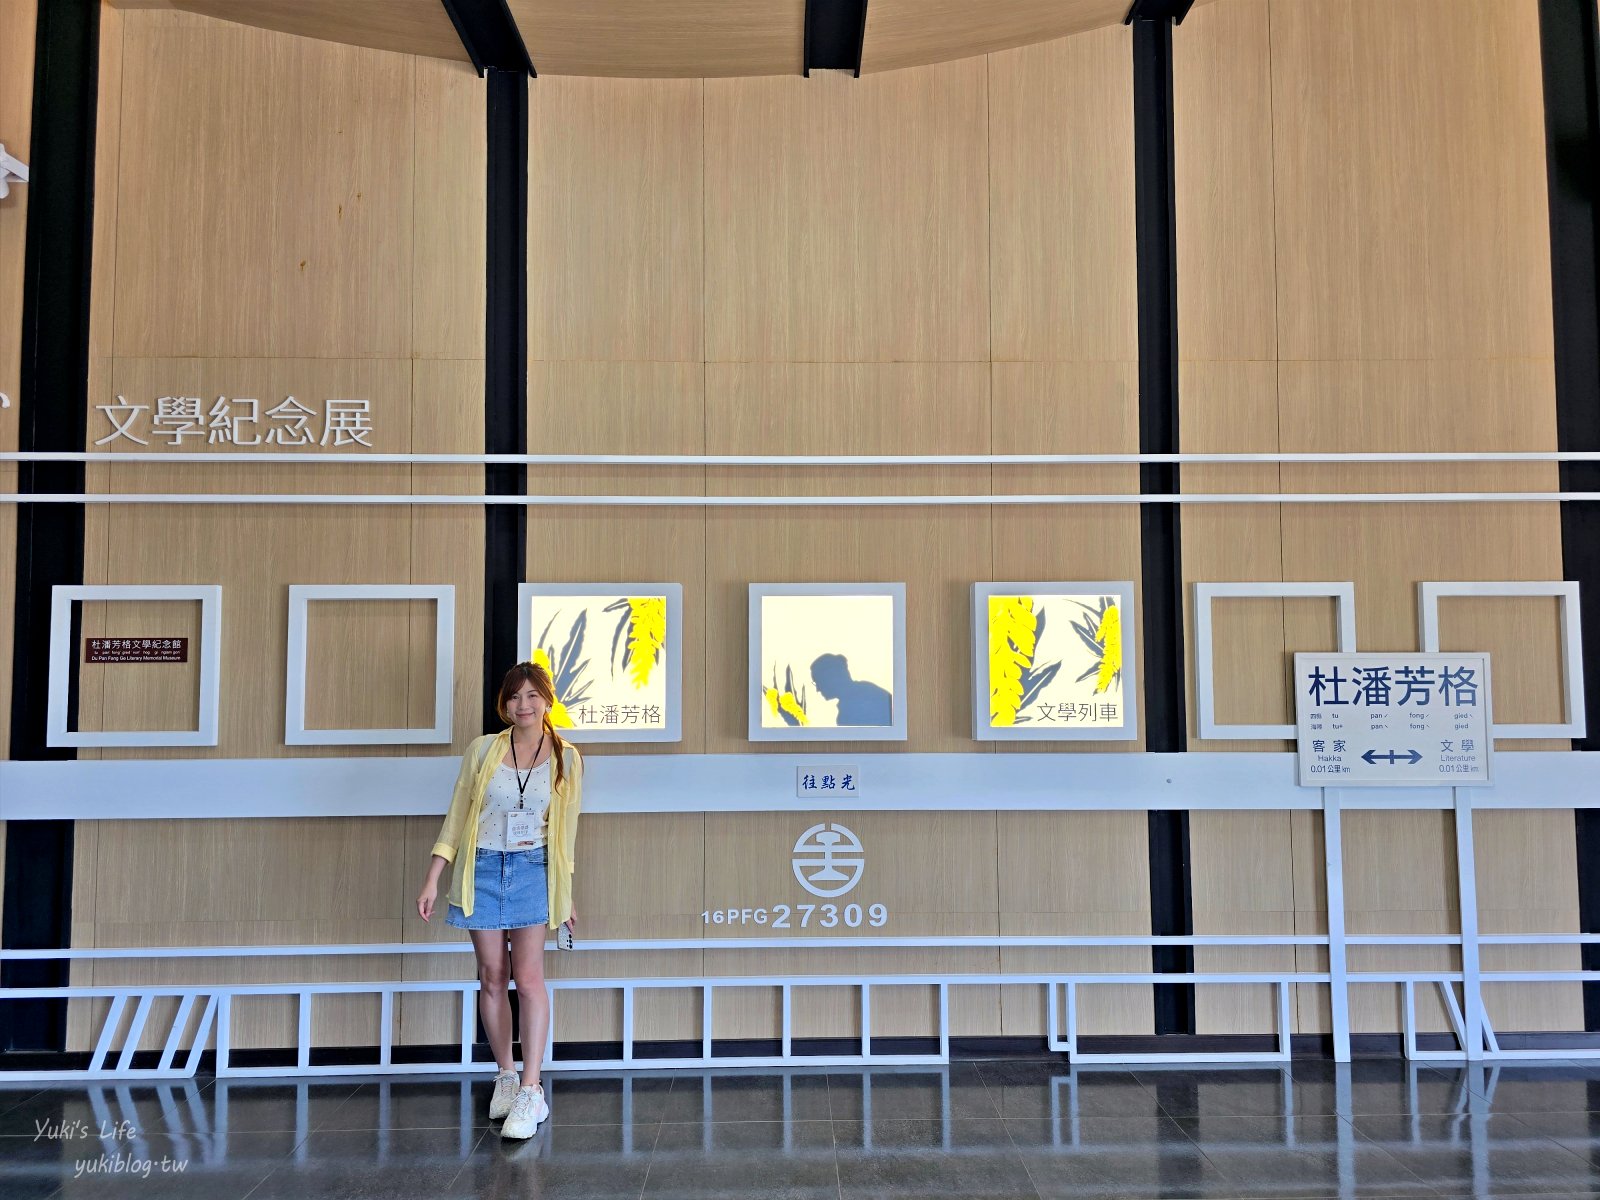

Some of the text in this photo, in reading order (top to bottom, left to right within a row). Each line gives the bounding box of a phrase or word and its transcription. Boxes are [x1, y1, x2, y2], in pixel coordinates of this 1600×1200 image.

[95, 395, 374, 447] 文學紀念展
[92, 639, 182, 649] 杜潘芳格文學紀念館
[1308, 666, 1478, 706] 杜潘芳格
[578, 704, 662, 724] 杜潘芳格
[1037, 703, 1118, 722] 文學列車
[1312, 739, 1346, 753] 客家
[1440, 739, 1475, 753] 文學
[1440, 754, 1476, 762] Literature
[802, 773, 856, 791] 往點光
